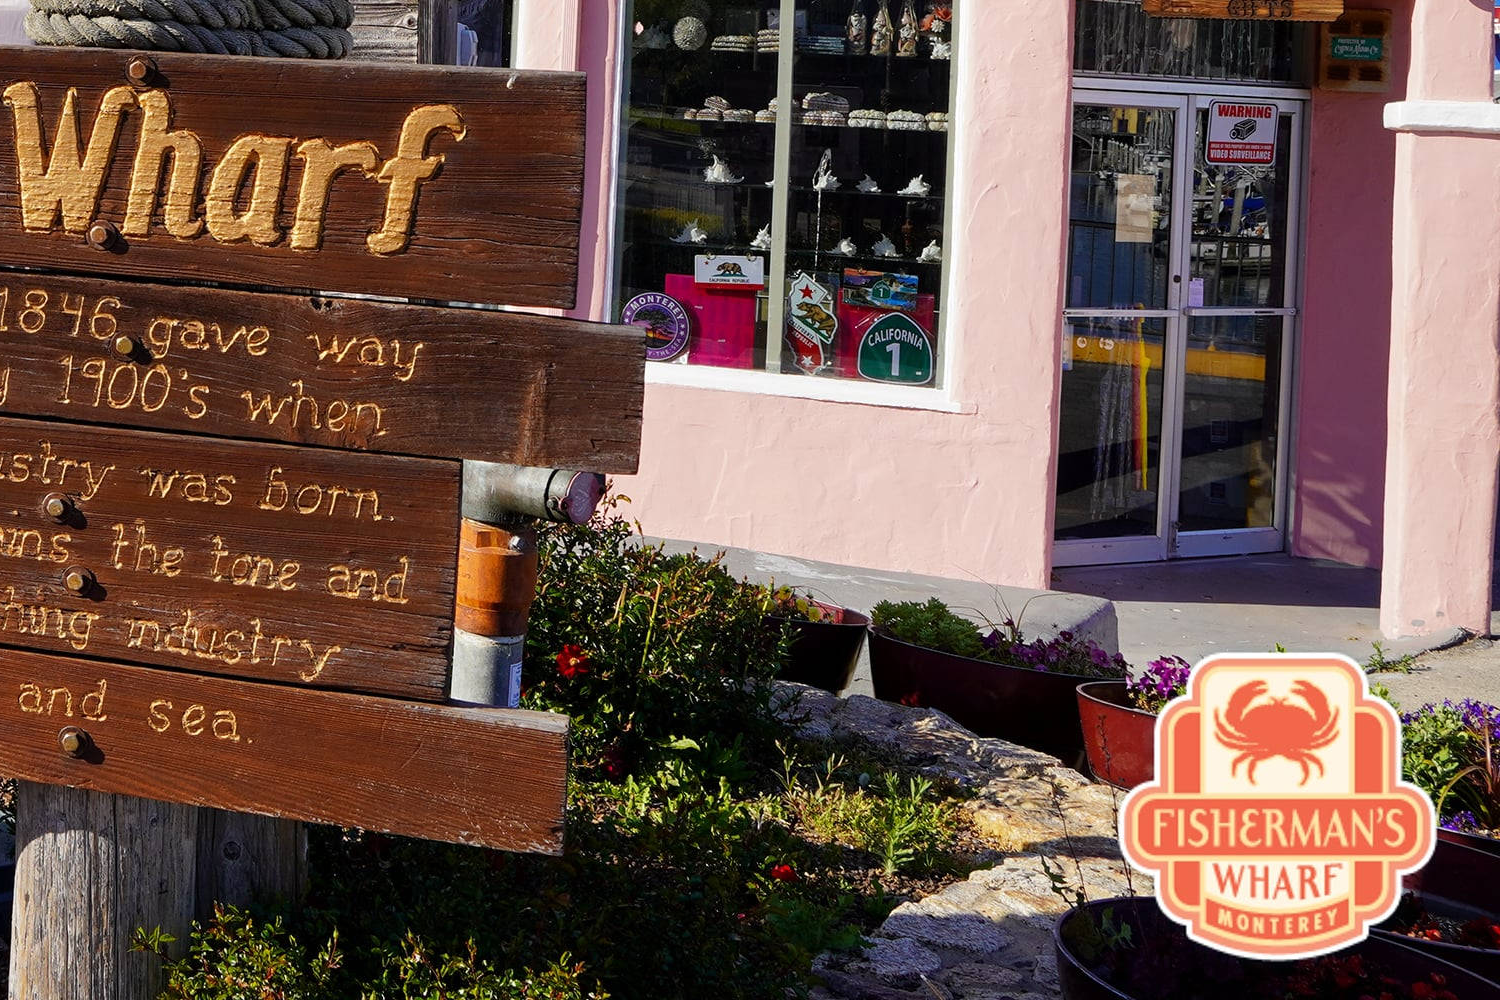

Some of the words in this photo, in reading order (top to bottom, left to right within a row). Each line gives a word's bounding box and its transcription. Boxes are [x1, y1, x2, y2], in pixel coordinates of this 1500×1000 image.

[1217, 104, 1272, 119] WARNING
[0, 81, 469, 256] Wharf
[1210, 149, 1229, 159] VIDEO
[1229, 149, 1271, 160] SURVEILLANCE
[630, 294, 686, 321] MONTEREY
[149, 316, 270, 360] gave
[306, 332, 424, 382] way
[868, 328, 924, 351] CALIFORNIA
[886, 343, 901, 377] 1
[56, 354, 210, 420] 1900's
[240, 378, 390, 437] when
[140, 467, 237, 506] was
[256, 464, 396, 522] born.
[112, 518, 185, 577] the
[210, 534, 301, 591] tone
[326, 554, 410, 605] and
[124, 602, 342, 683] industry
[17, 678, 108, 722] and
[147, 698, 255, 744] sea.
